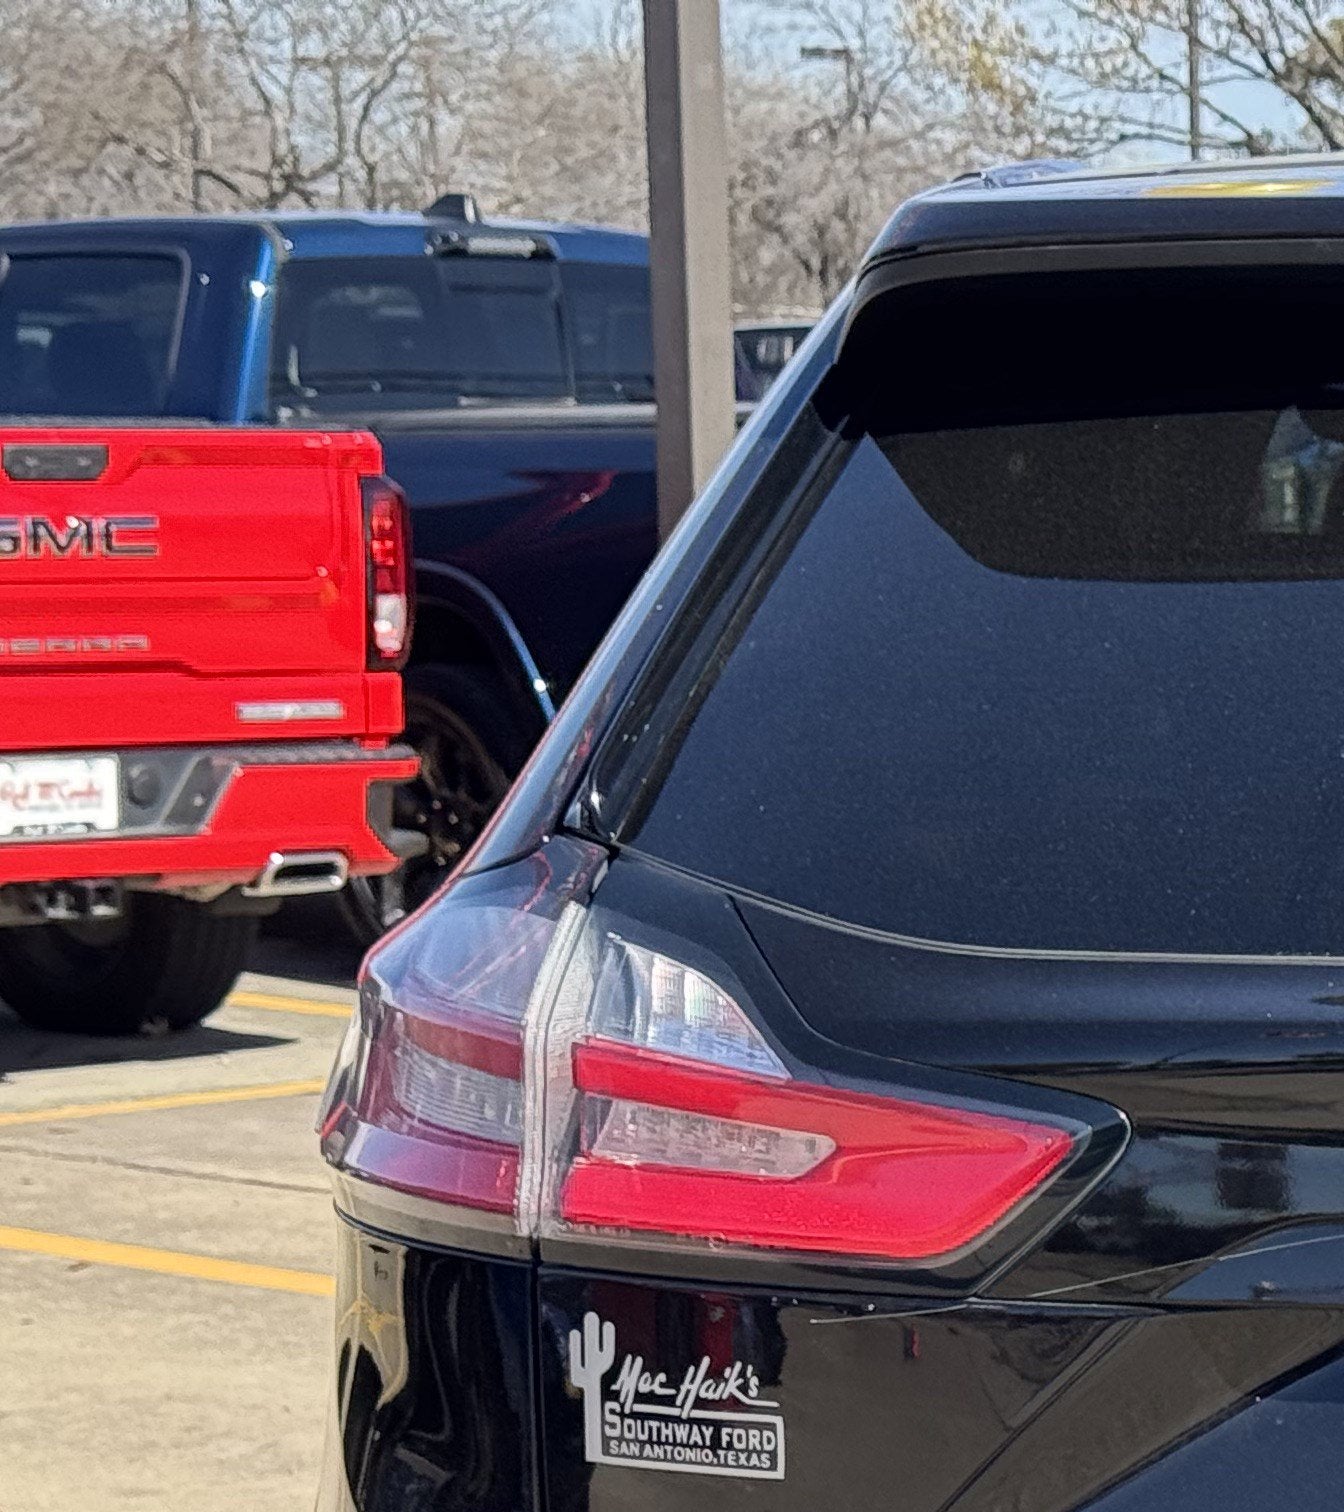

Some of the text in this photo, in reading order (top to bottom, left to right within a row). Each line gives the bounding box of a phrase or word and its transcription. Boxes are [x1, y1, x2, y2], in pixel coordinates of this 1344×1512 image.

[610, 1354, 780, 1419] Mac Haik's
[604, 1401, 776, 1451] SOUTHWAY FORD
[609, 1439, 641, 1457] SAN
